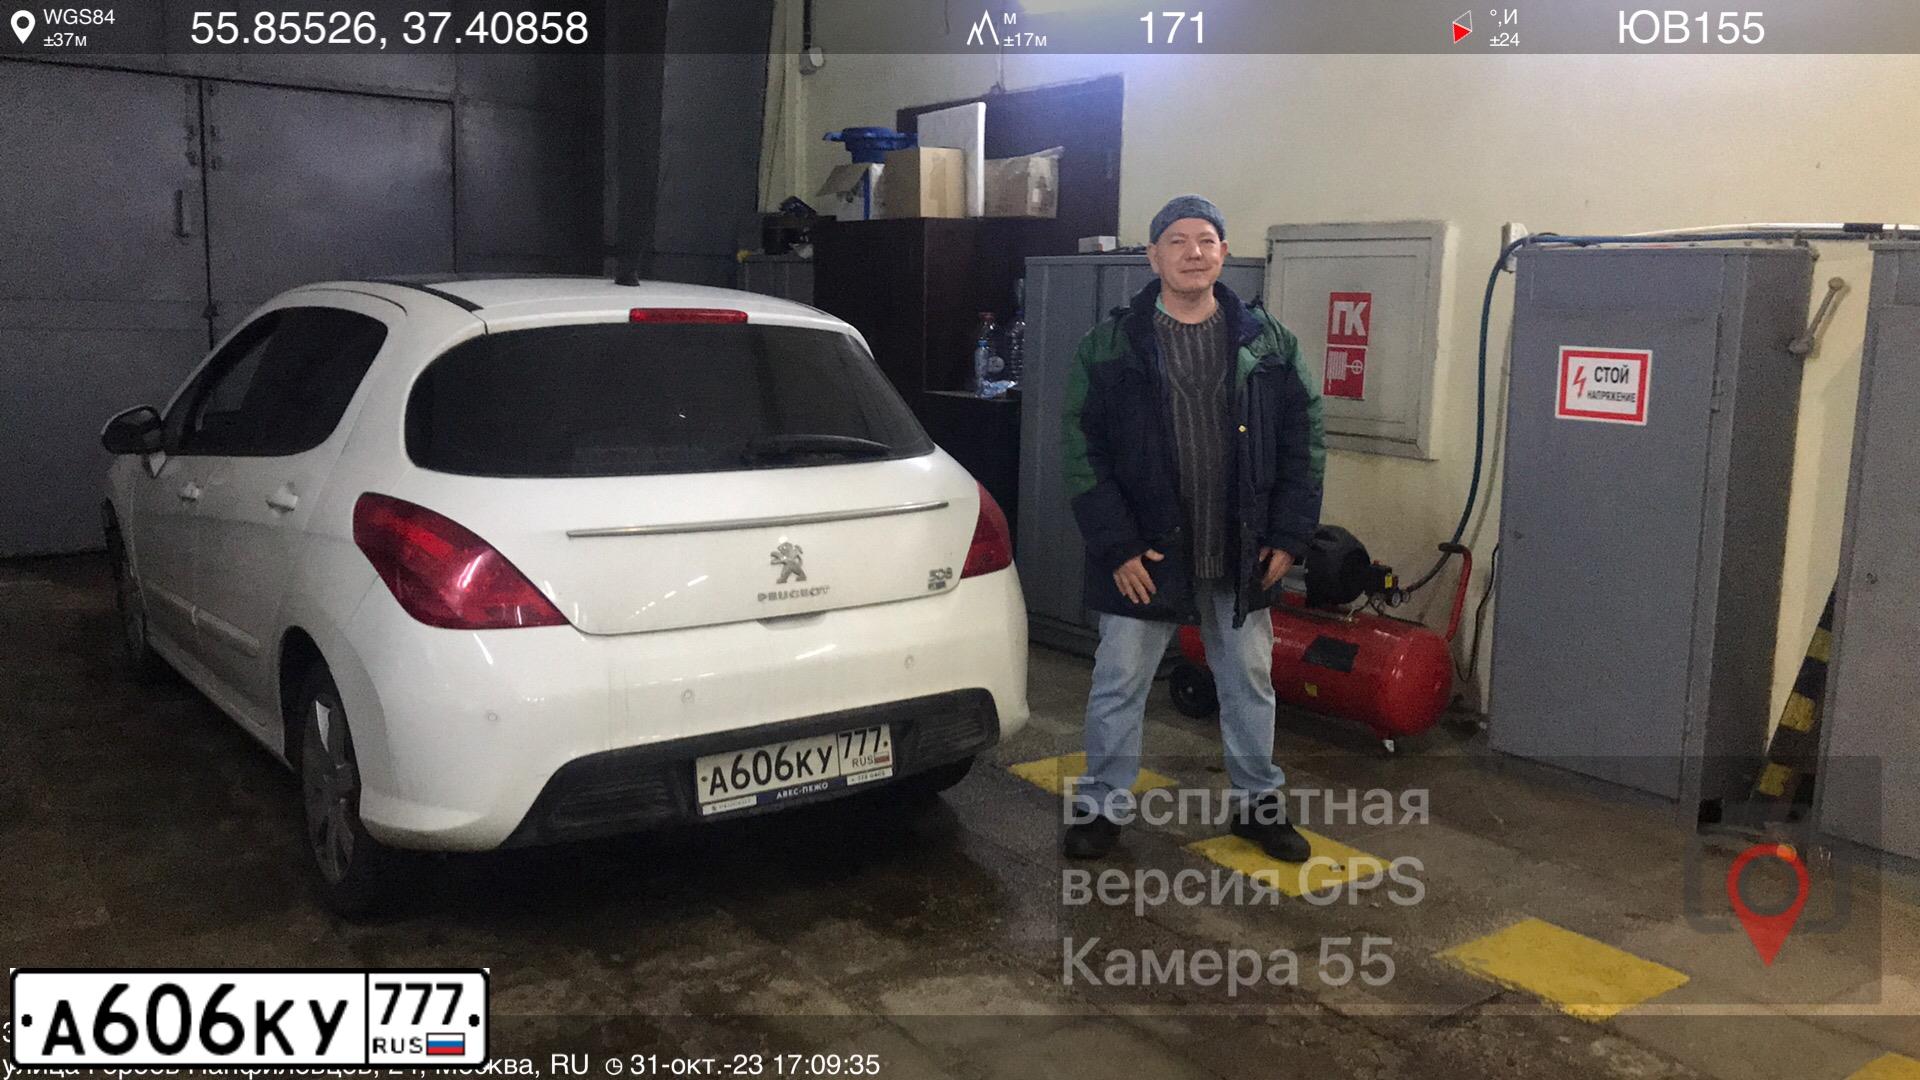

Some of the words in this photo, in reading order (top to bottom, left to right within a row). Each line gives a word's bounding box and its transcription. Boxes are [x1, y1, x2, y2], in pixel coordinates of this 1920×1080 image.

[1331, 301, 1367, 336] ПК
[1594, 365, 1630, 384] СТОЙ
[1587, 390, 1636, 403] НАПРЯЖЕНИЕ
[757, 585, 830, 602] PEUGEOT
[709, 745, 832, 796] А606КУ
[840, 727, 882, 760] 777
[852, 753, 874, 768] RUS
